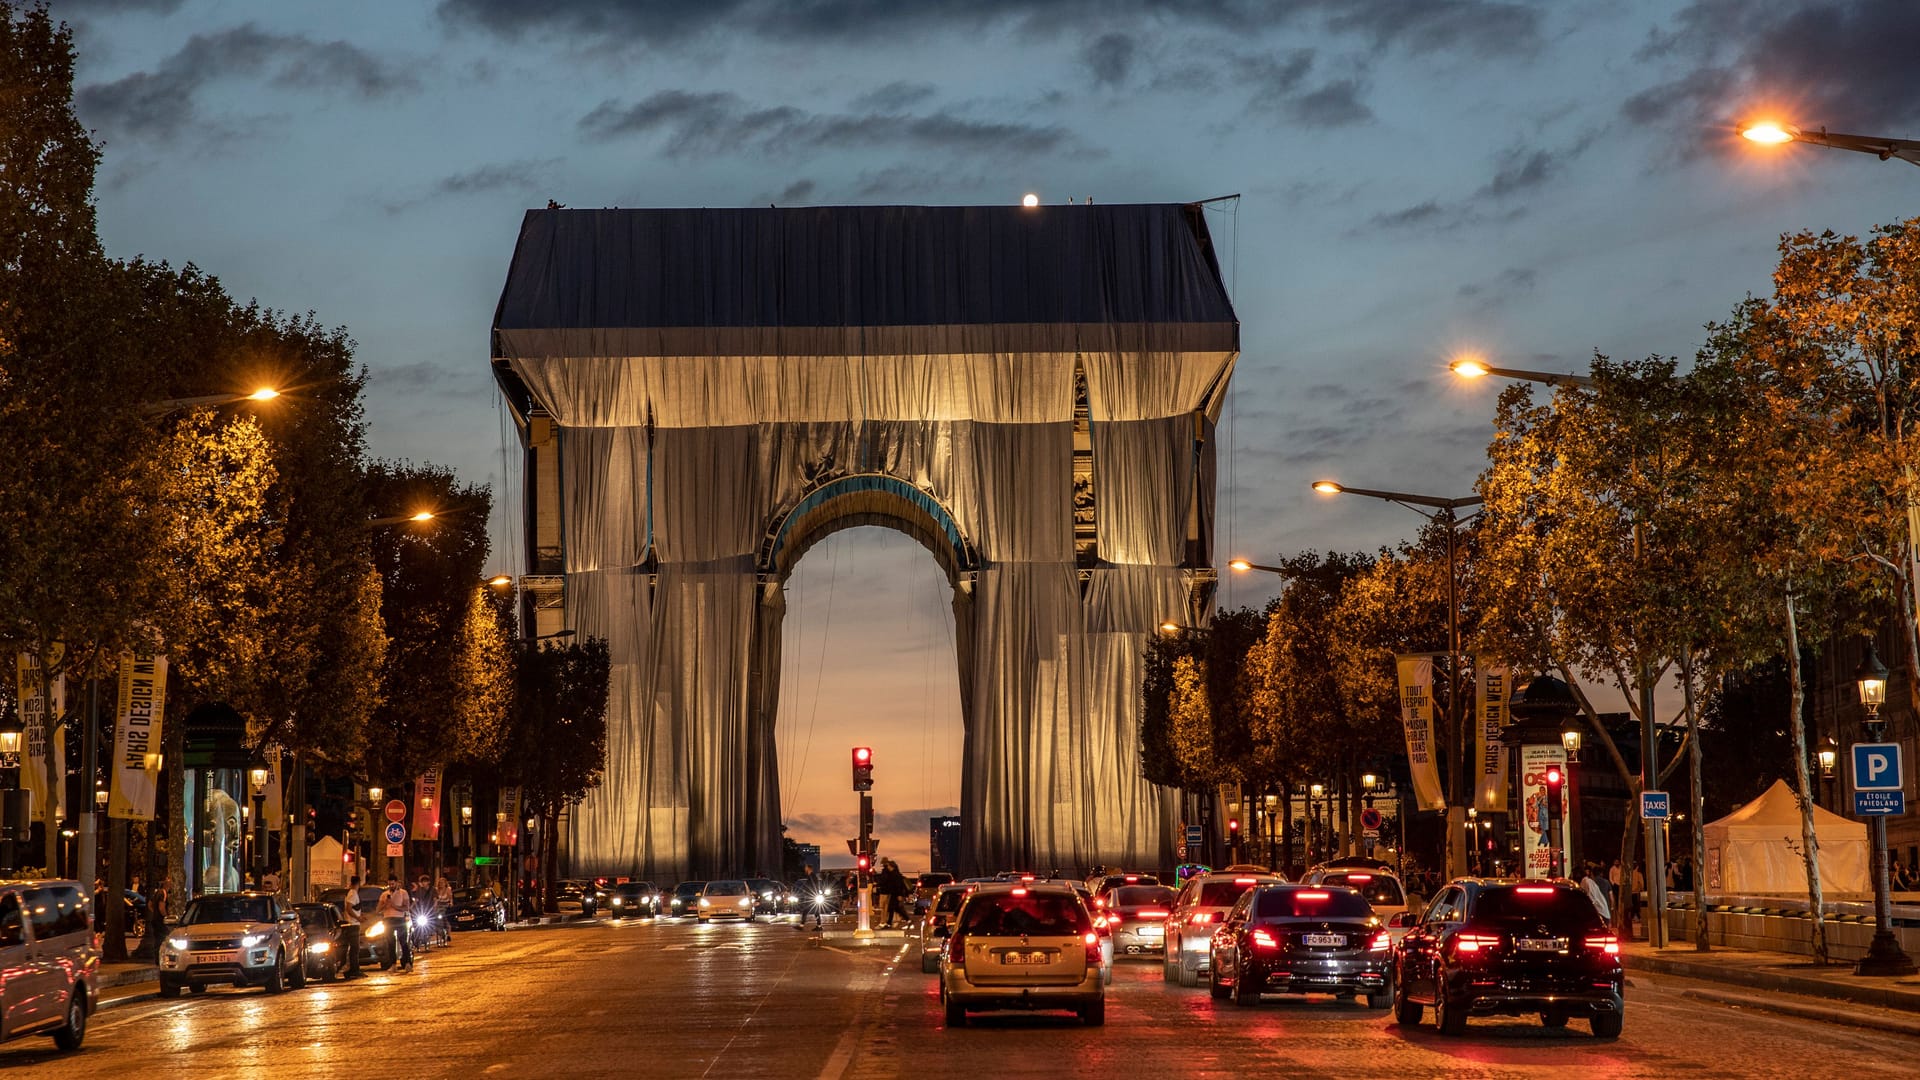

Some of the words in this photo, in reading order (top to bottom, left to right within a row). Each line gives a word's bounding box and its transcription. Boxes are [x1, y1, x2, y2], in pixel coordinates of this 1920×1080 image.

[1405, 685, 1423, 697] TOUT
[1487, 674, 1502, 702] WEEK
[1405, 719, 1428, 730] MAISON
[1486, 705, 1500, 741] DESIGN
[1485, 745, 1498, 775] PARIS
[1867, 753, 1889, 782] P
[1644, 800, 1667, 810] TAXIS
